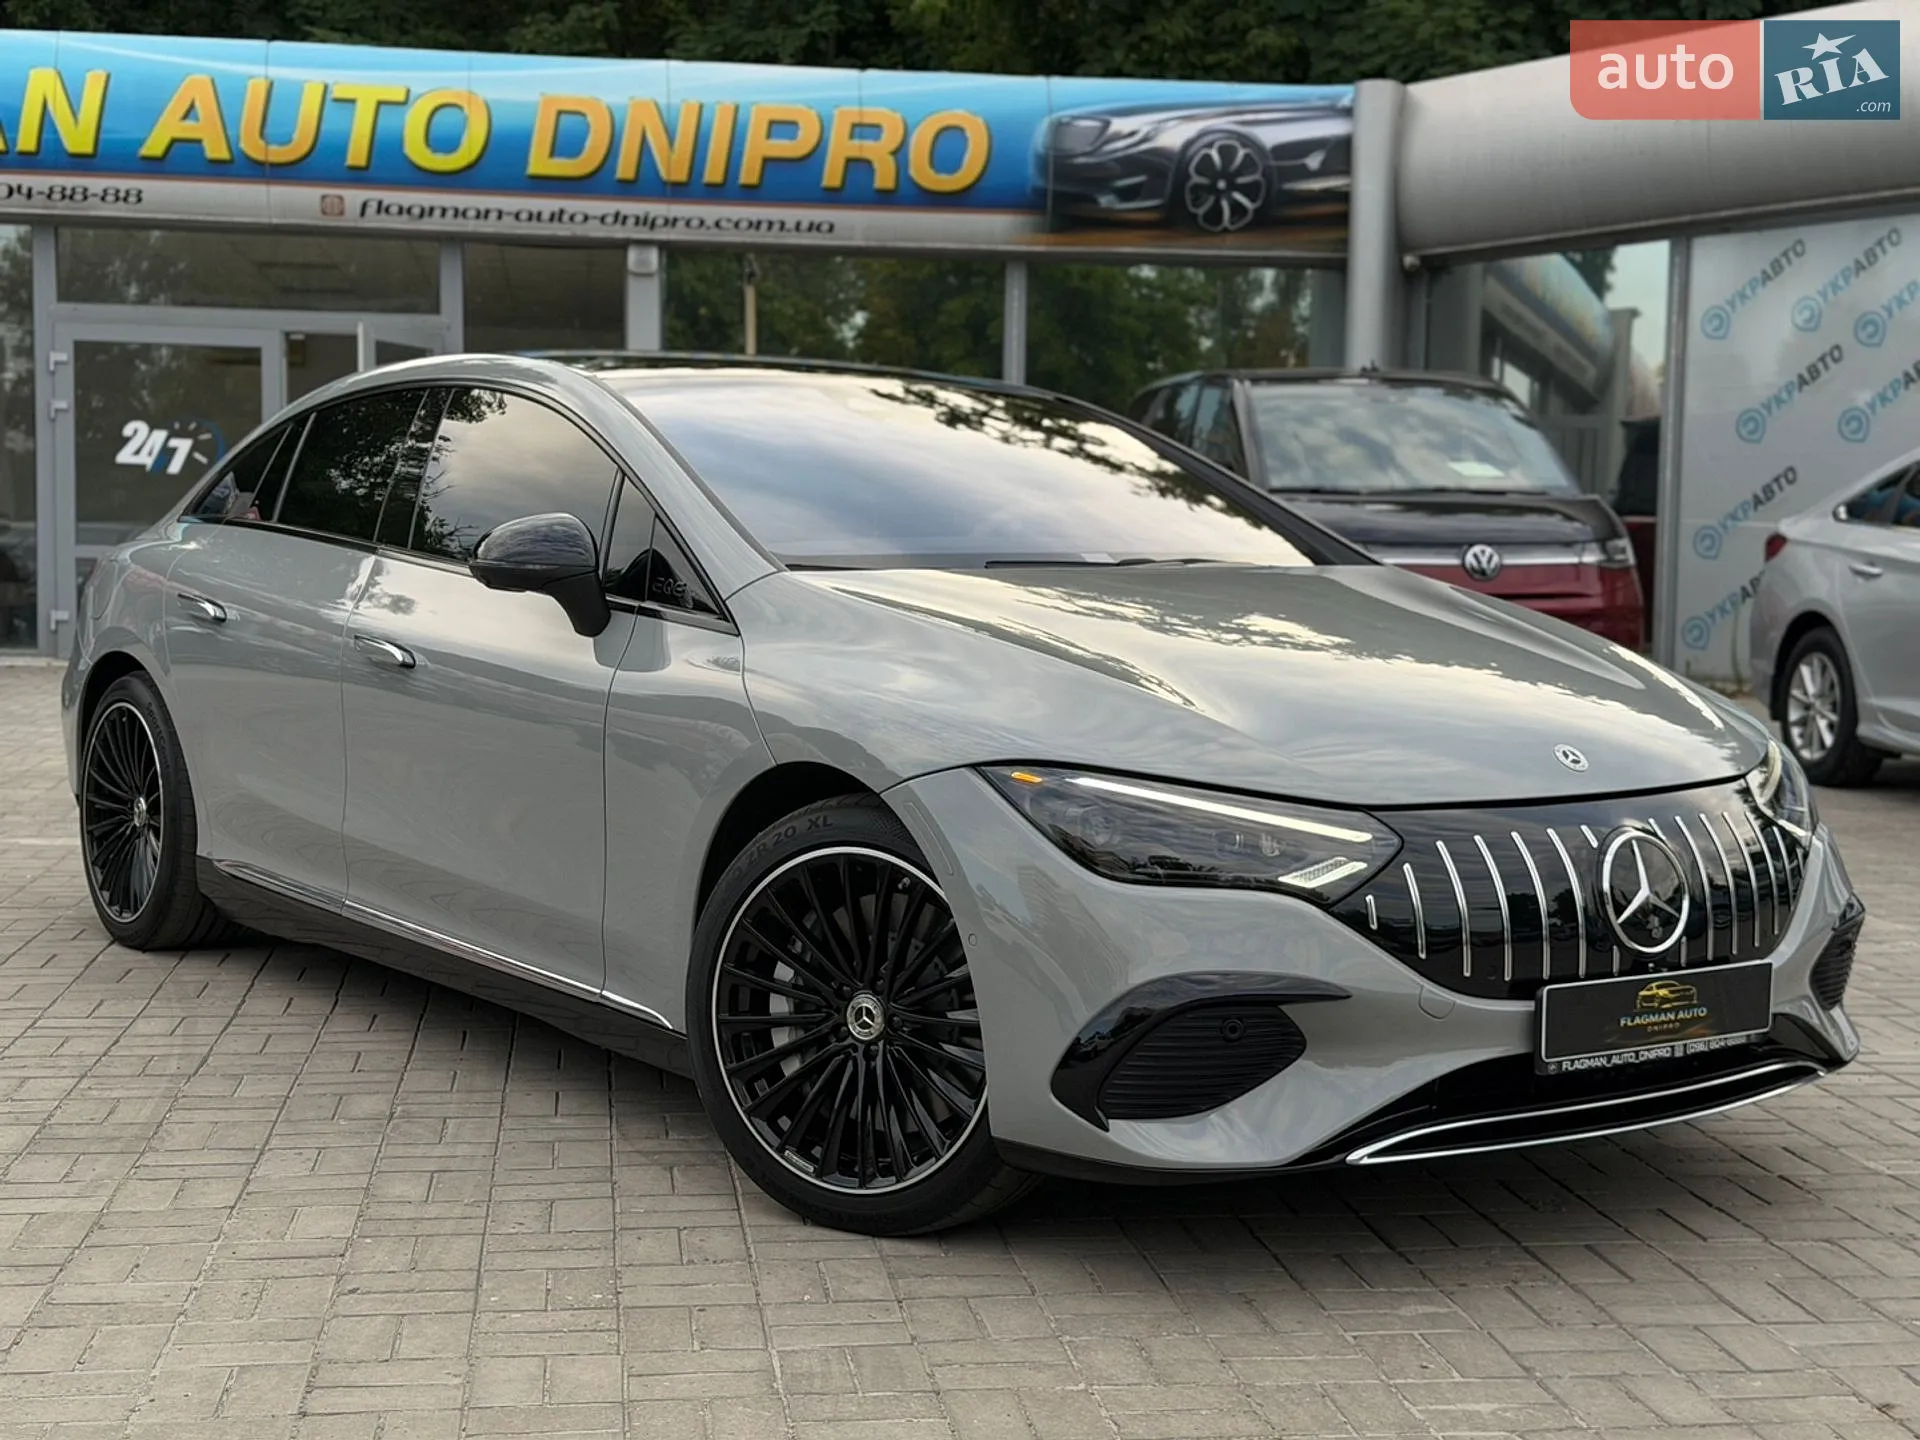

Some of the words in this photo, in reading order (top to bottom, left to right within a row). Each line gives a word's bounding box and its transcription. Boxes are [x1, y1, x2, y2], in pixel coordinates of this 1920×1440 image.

[0, 68, 110, 158] N
[138, 74, 492, 174] AUTO
[526, 92, 990, 194] DNIPRO
[359, 197, 835, 235] flagman-auto-dnipro.com.ua
[1725, 239, 1807, 313] УКРАВТО
[1817, 228, 1903, 305] УКРАВТО
[1759, 343, 1844, 417] УКРАВТО
[1719, 466, 1798, 535] УКРАВТО
[772, 825, 797, 847] 20
[807, 814, 834, 831] XL
[1620, 1011, 1676, 1028] FLAGMAN
[1677, 1006, 1708, 1020] AUTO
